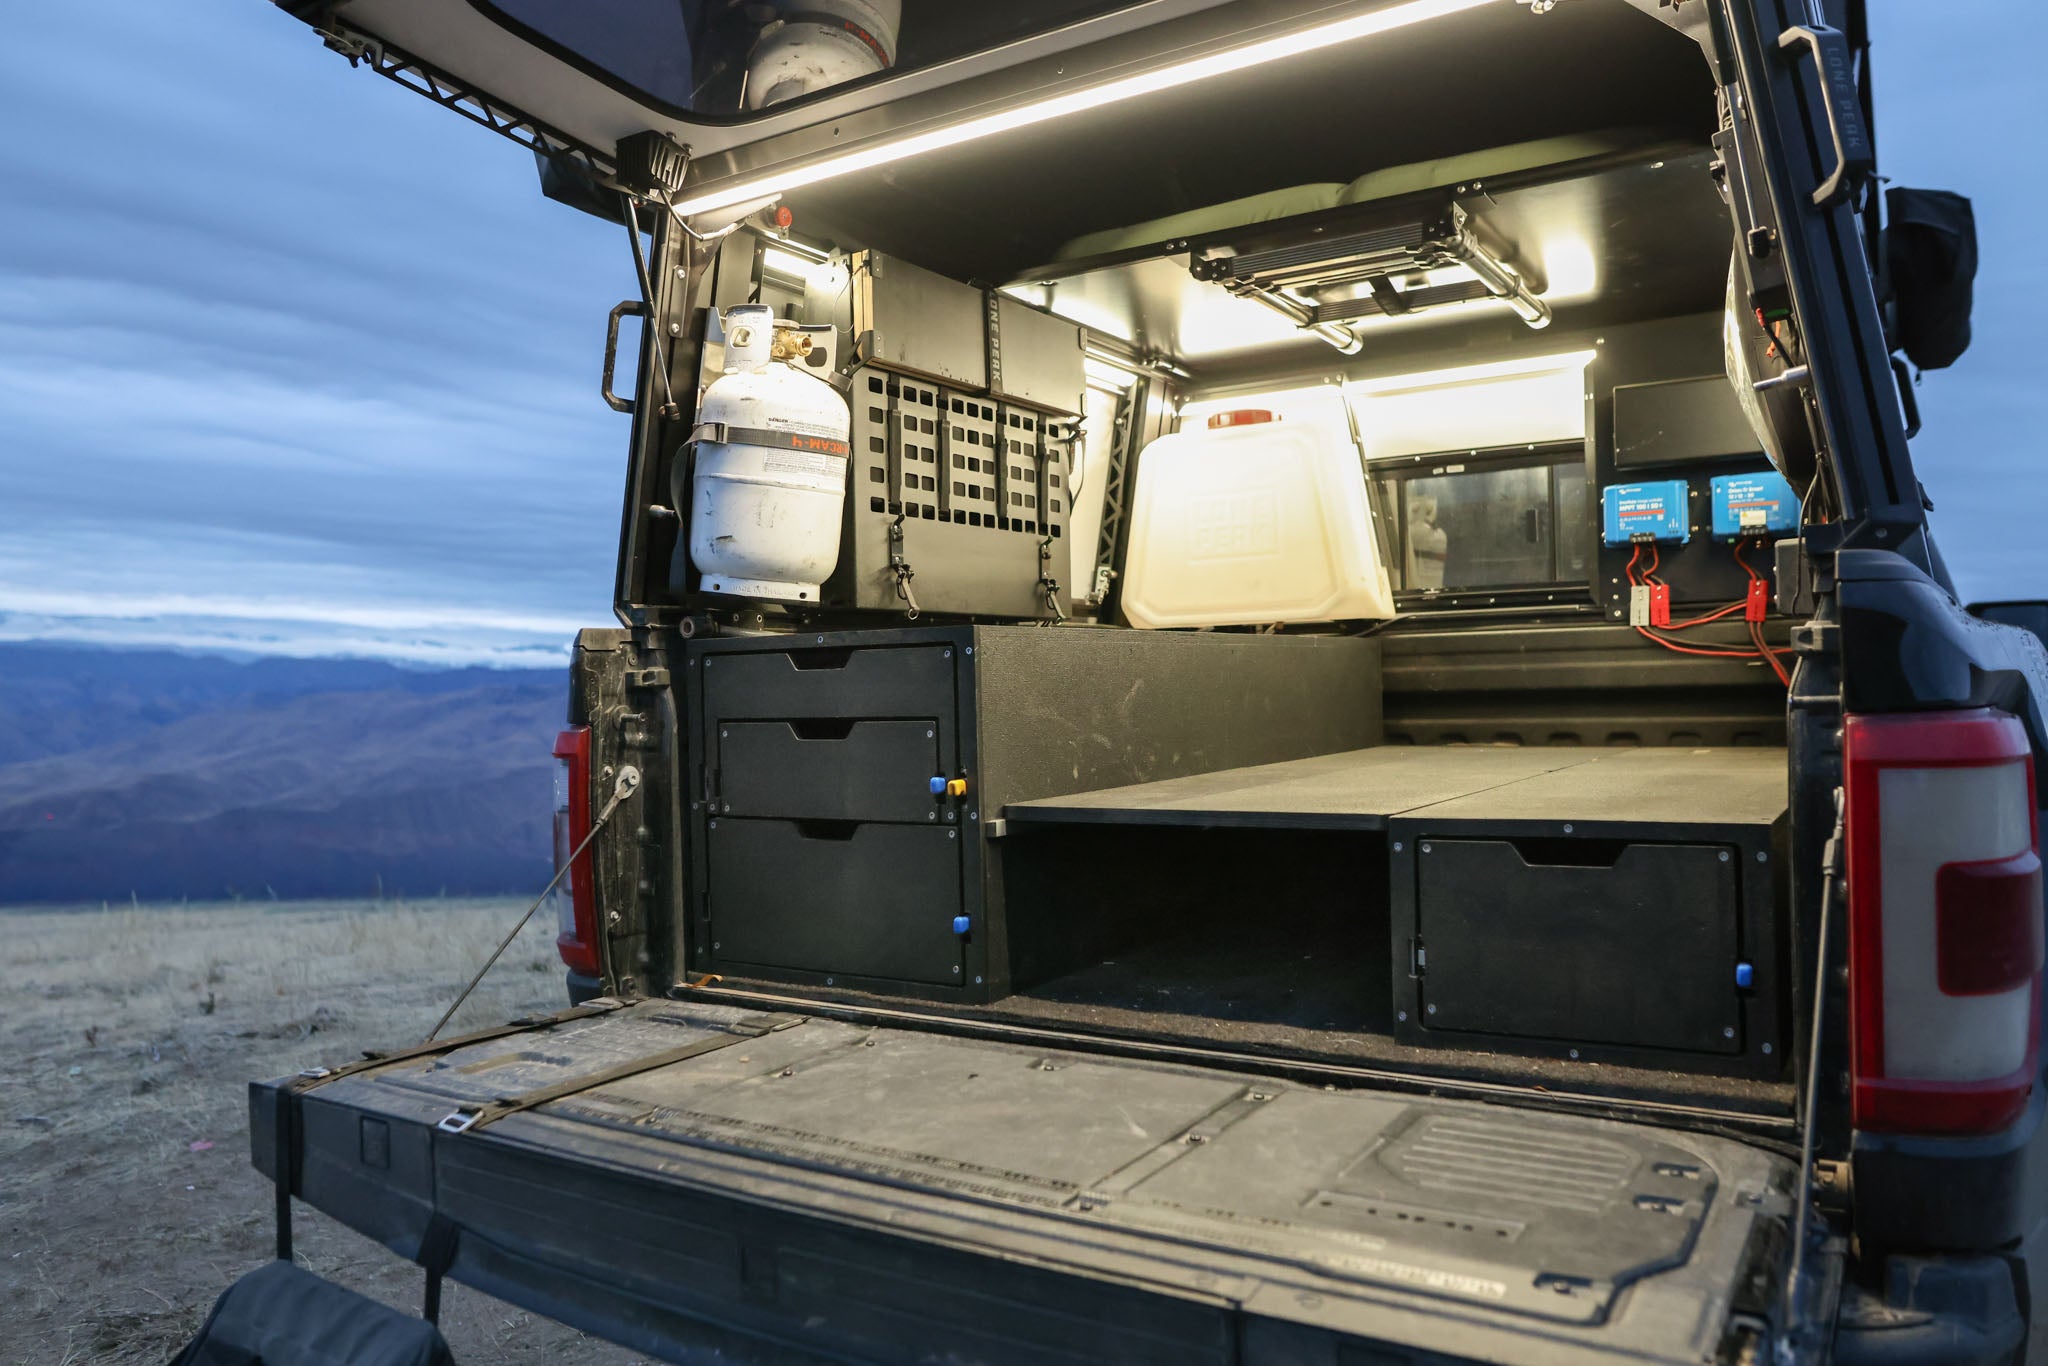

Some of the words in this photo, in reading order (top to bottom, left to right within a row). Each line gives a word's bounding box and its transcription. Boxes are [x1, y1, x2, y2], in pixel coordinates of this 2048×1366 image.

[1826, 47, 1849, 92] LONE
[1841, 99, 1862, 148] PEAK
[989, 290, 999, 333] LONE
[991, 337, 1001, 381] PEAK
